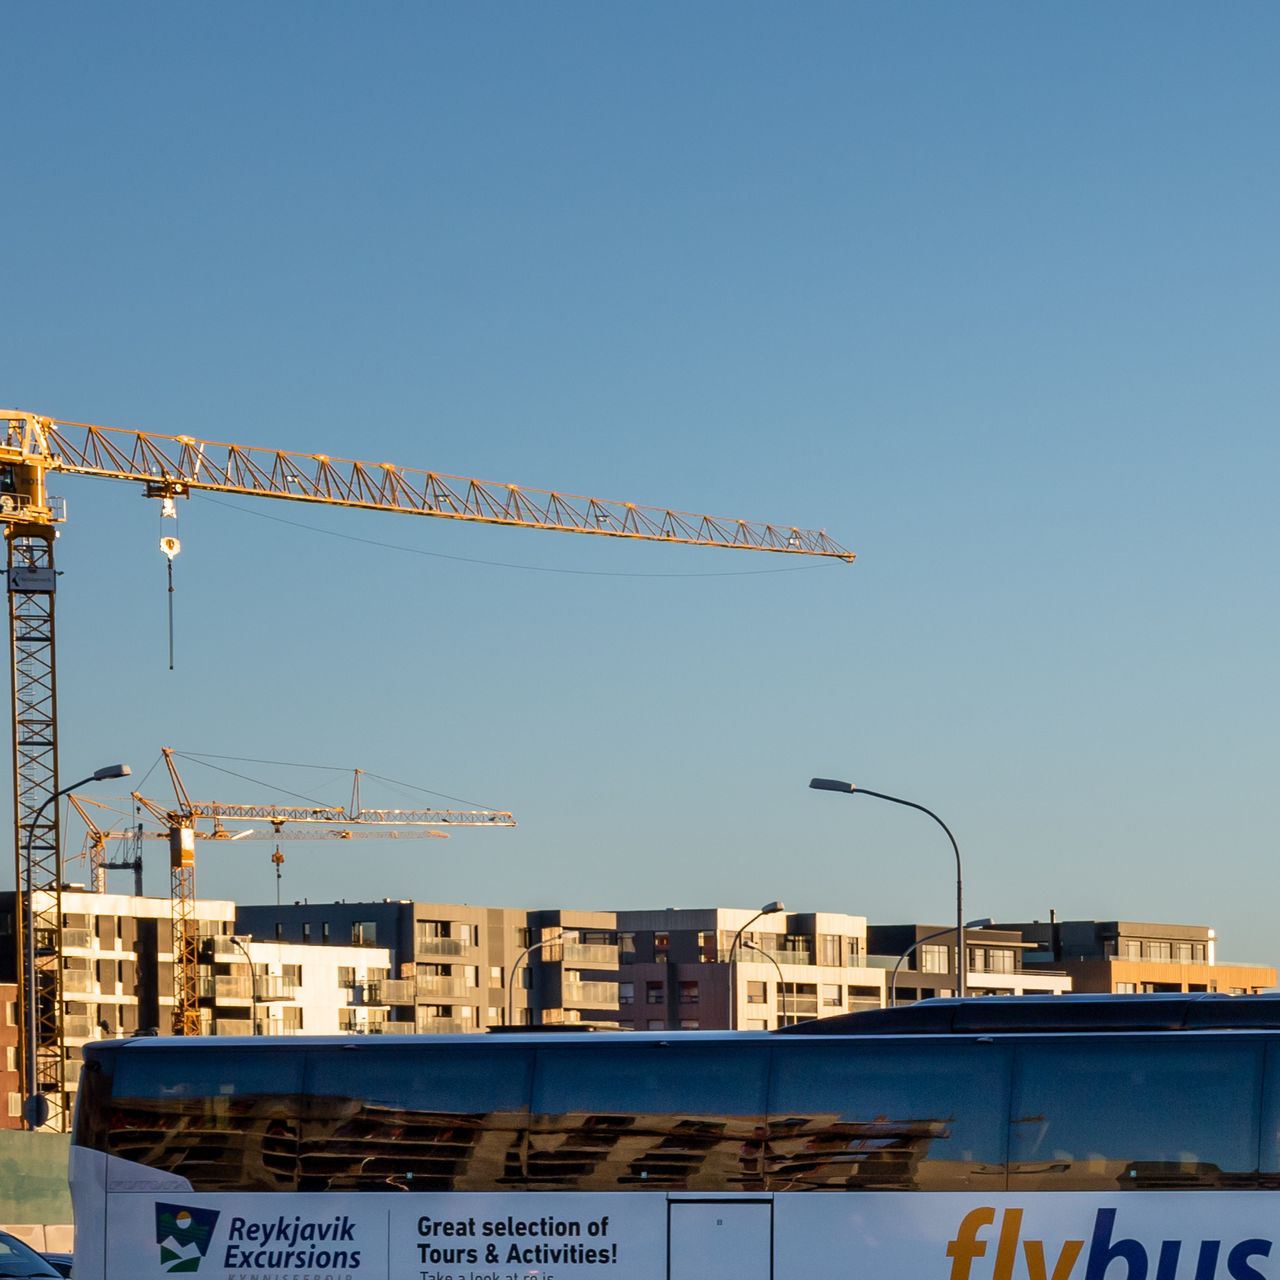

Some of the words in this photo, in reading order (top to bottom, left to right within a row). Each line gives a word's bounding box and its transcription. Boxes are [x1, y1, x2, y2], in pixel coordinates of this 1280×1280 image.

[228, 1216, 356, 1248] Reykjavik
[417, 1216, 476, 1237] Great
[482, 1216, 581, 1237] selection
[587, 1216, 609, 1237] of
[223, 1245, 361, 1270] Excursions
[417, 1243, 478, 1264] Tours
[485, 1243, 499, 1264] &
[506, 1243, 618, 1264] Activities!
